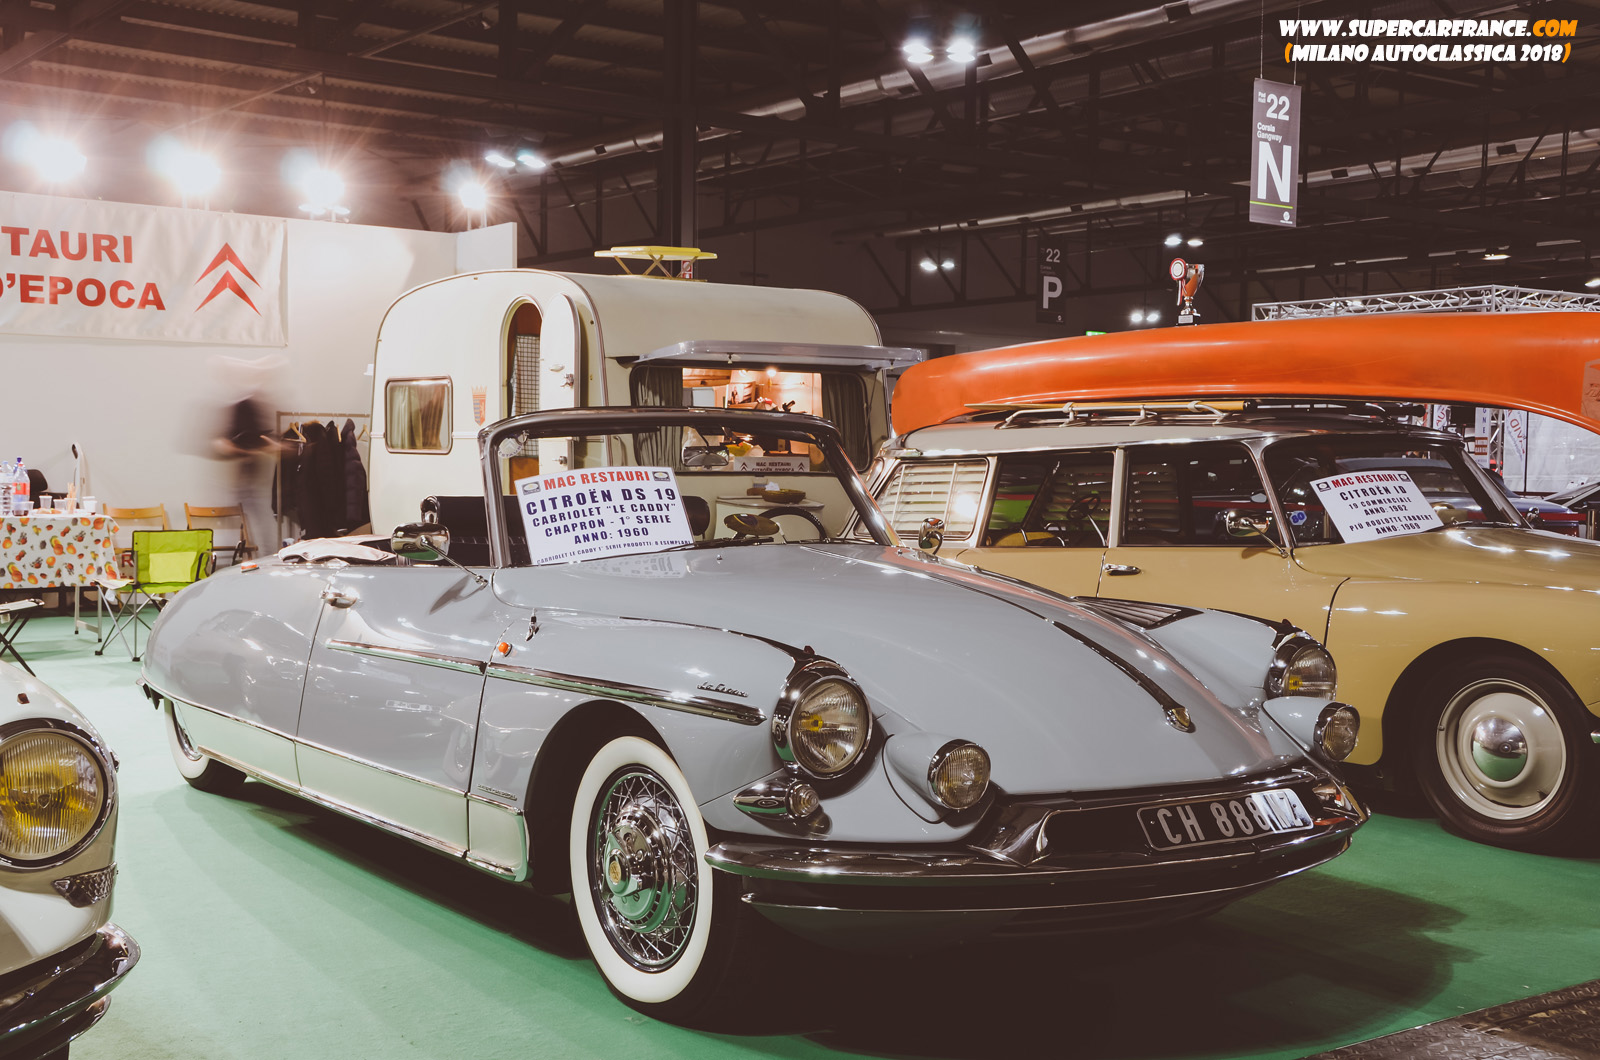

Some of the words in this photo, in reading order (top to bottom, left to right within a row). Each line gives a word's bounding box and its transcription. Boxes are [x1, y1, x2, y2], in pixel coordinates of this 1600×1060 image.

[1266, 93, 1290, 121] 22
[1257, 122, 1276, 133] Corsia
[1257, 130, 1282, 143] Gangway
[1257, 141, 1292, 203] N
[1, 226, 133, 264] TAURI
[1046, 248, 1061, 263] 22
[1042, 276, 1063, 309] P
[544, 475, 576, 490] MAC
[580, 471, 650, 485] RESTAURI
[1331, 478, 1354, 489] MAC
[1354, 473, 1399, 485] RESTAURI
[526, 489, 613, 515] CITROËN
[622, 488, 647, 501] DS
[655, 488, 676, 501] 19
[1339, 484, 1391, 502] CITROËN
[1395, 485, 1407, 494] ID
[1349, 502, 1359, 510] 19
[1361, 497, 1412, 508] COMMERCIALE
[1363, 507, 1389, 516] ANNO:
[1389, 504, 1408, 513] 1962
[532, 506, 601, 527] CABRIOLET
[545, 519, 605, 537] CHAPRON
[636, 514, 671, 524] SERIE
[1365, 516, 1402, 528] ROULOTTE
[1403, 514, 1433, 522] TABBERT
[574, 532, 613, 545] ANNO:
[618, 527, 649, 538] 1960
[1375, 525, 1401, 535] ANNO:
[1157, 805, 1206, 844] CH
[1210, 797, 1271, 838] 888
